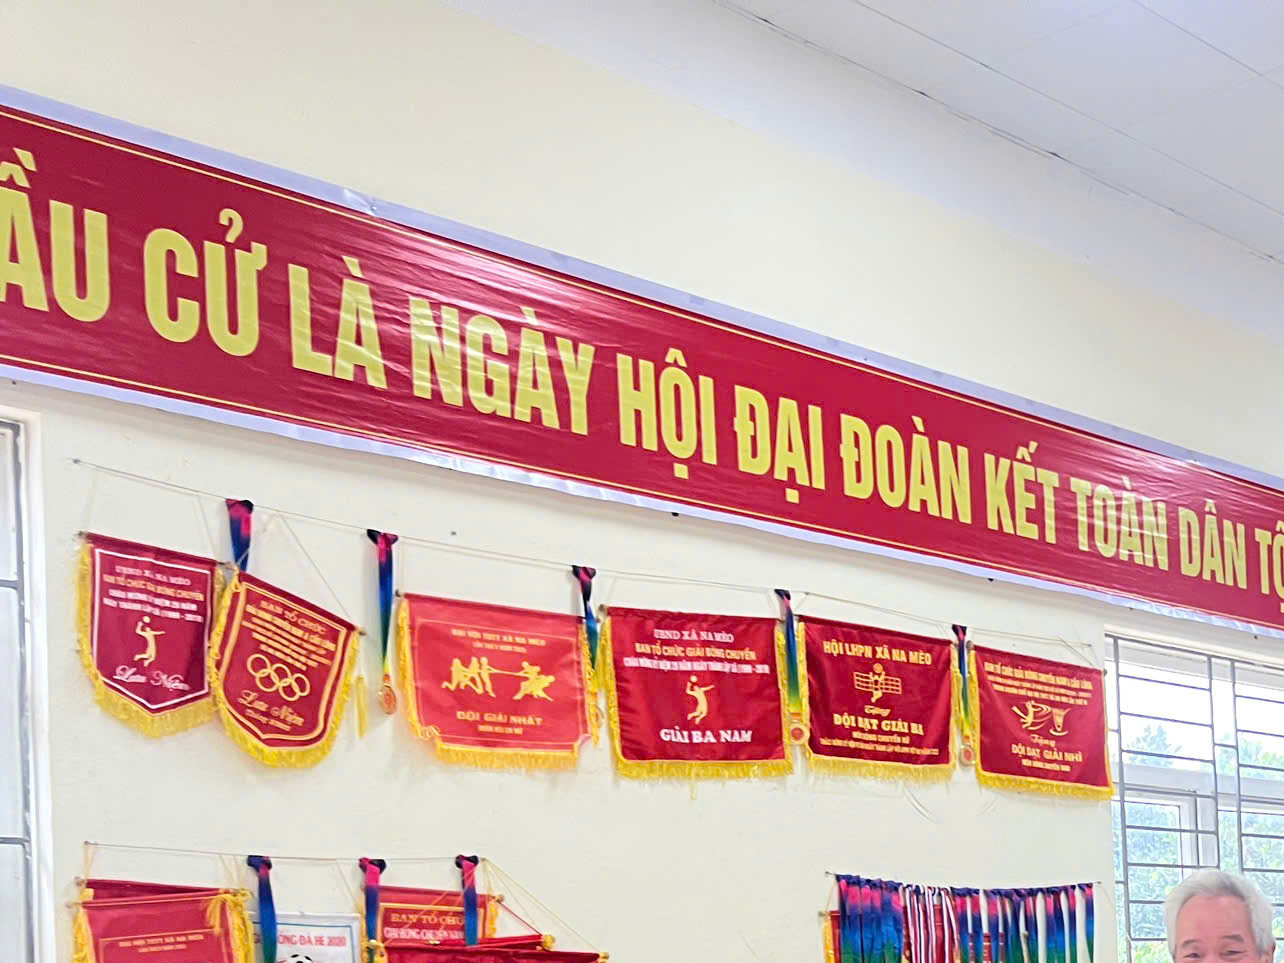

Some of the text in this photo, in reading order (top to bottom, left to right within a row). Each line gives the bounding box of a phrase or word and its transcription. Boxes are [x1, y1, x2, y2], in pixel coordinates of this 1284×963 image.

[143, 208, 268, 358] CỬ
[287, 255, 388, 390] LÀ
[409, 294, 595, 436] NGÀY
[616, 347, 716, 478] HỘI
[733, 384, 825, 506] ĐẠI
[839, 414, 973, 525] ĐOÀN
[984, 439, 1062, 543] KẾT
[1069, 472, 1169, 572] TOÀN
[1179, 498, 1248, 593] DÂN
